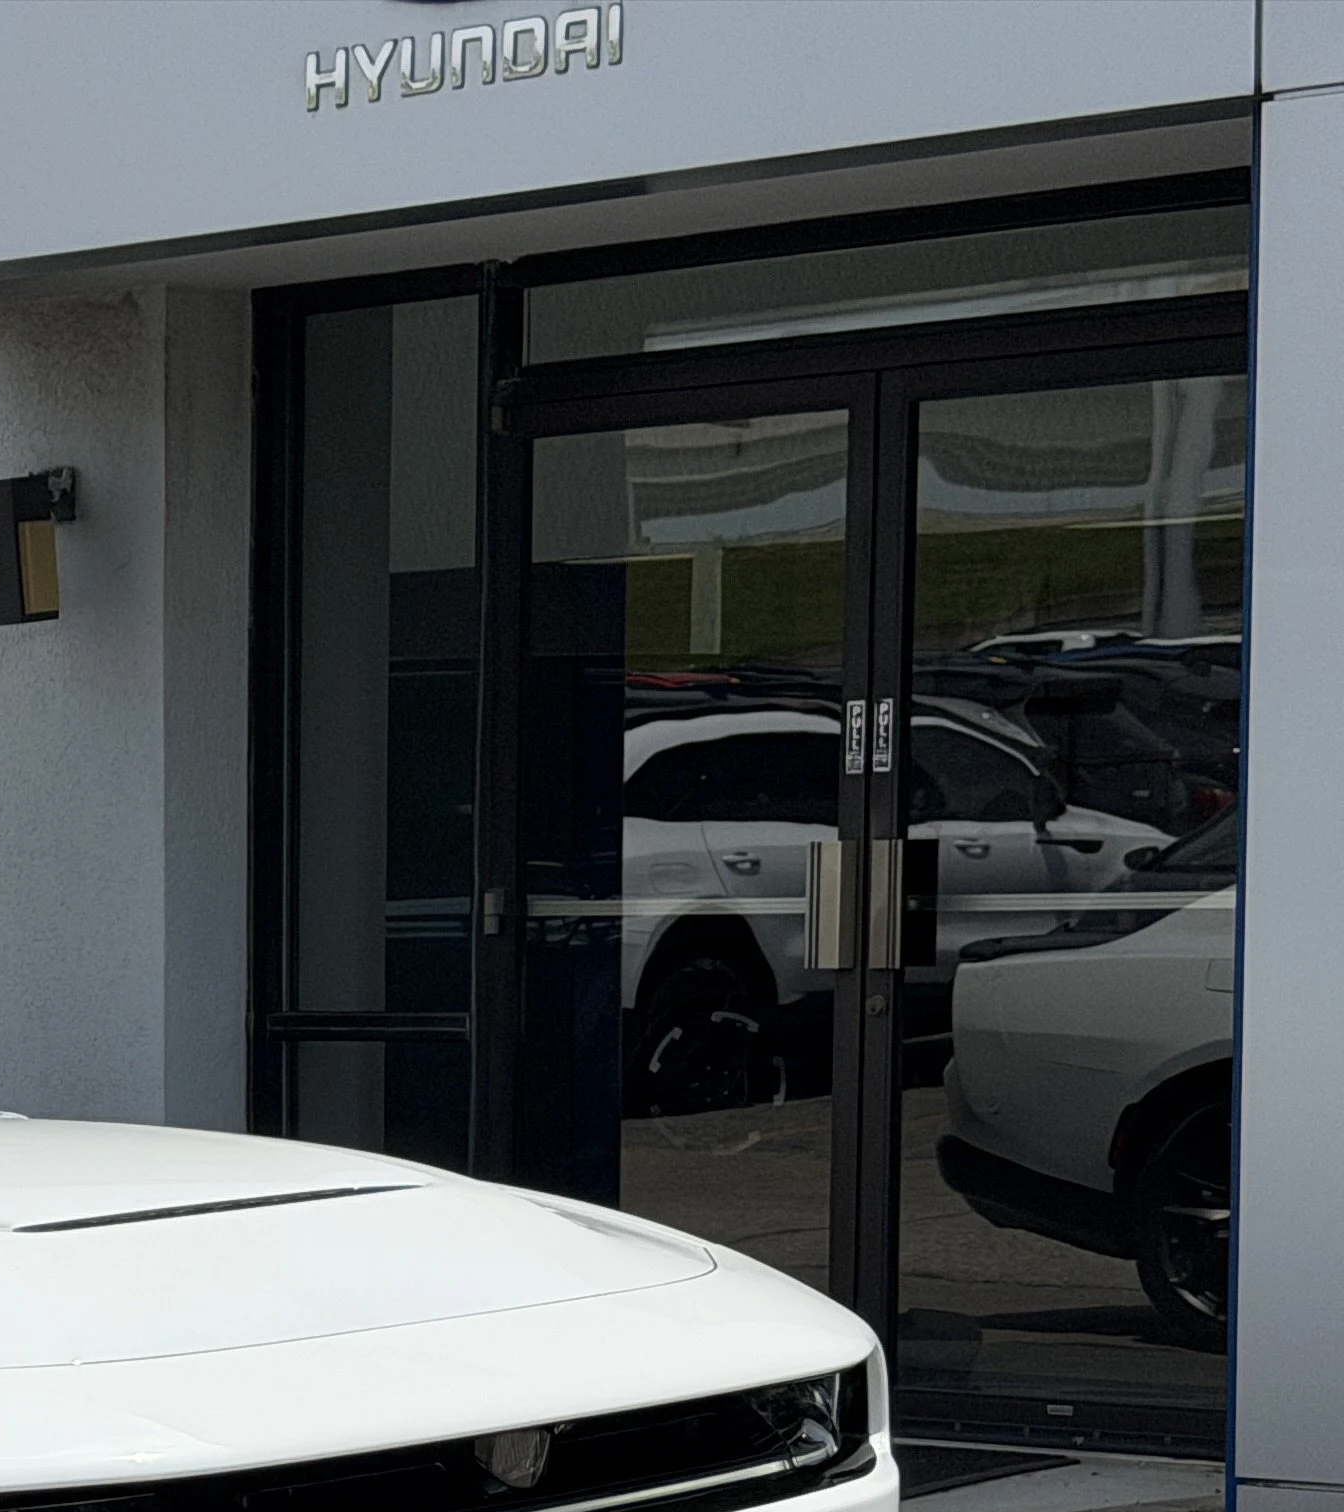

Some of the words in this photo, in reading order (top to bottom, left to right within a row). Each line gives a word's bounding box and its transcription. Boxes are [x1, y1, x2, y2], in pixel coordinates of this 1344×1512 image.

[305, 4, 624, 112] HYUNDAI
[849, 706, 862, 750] PULL
[878, 702, 890, 748] PULL
